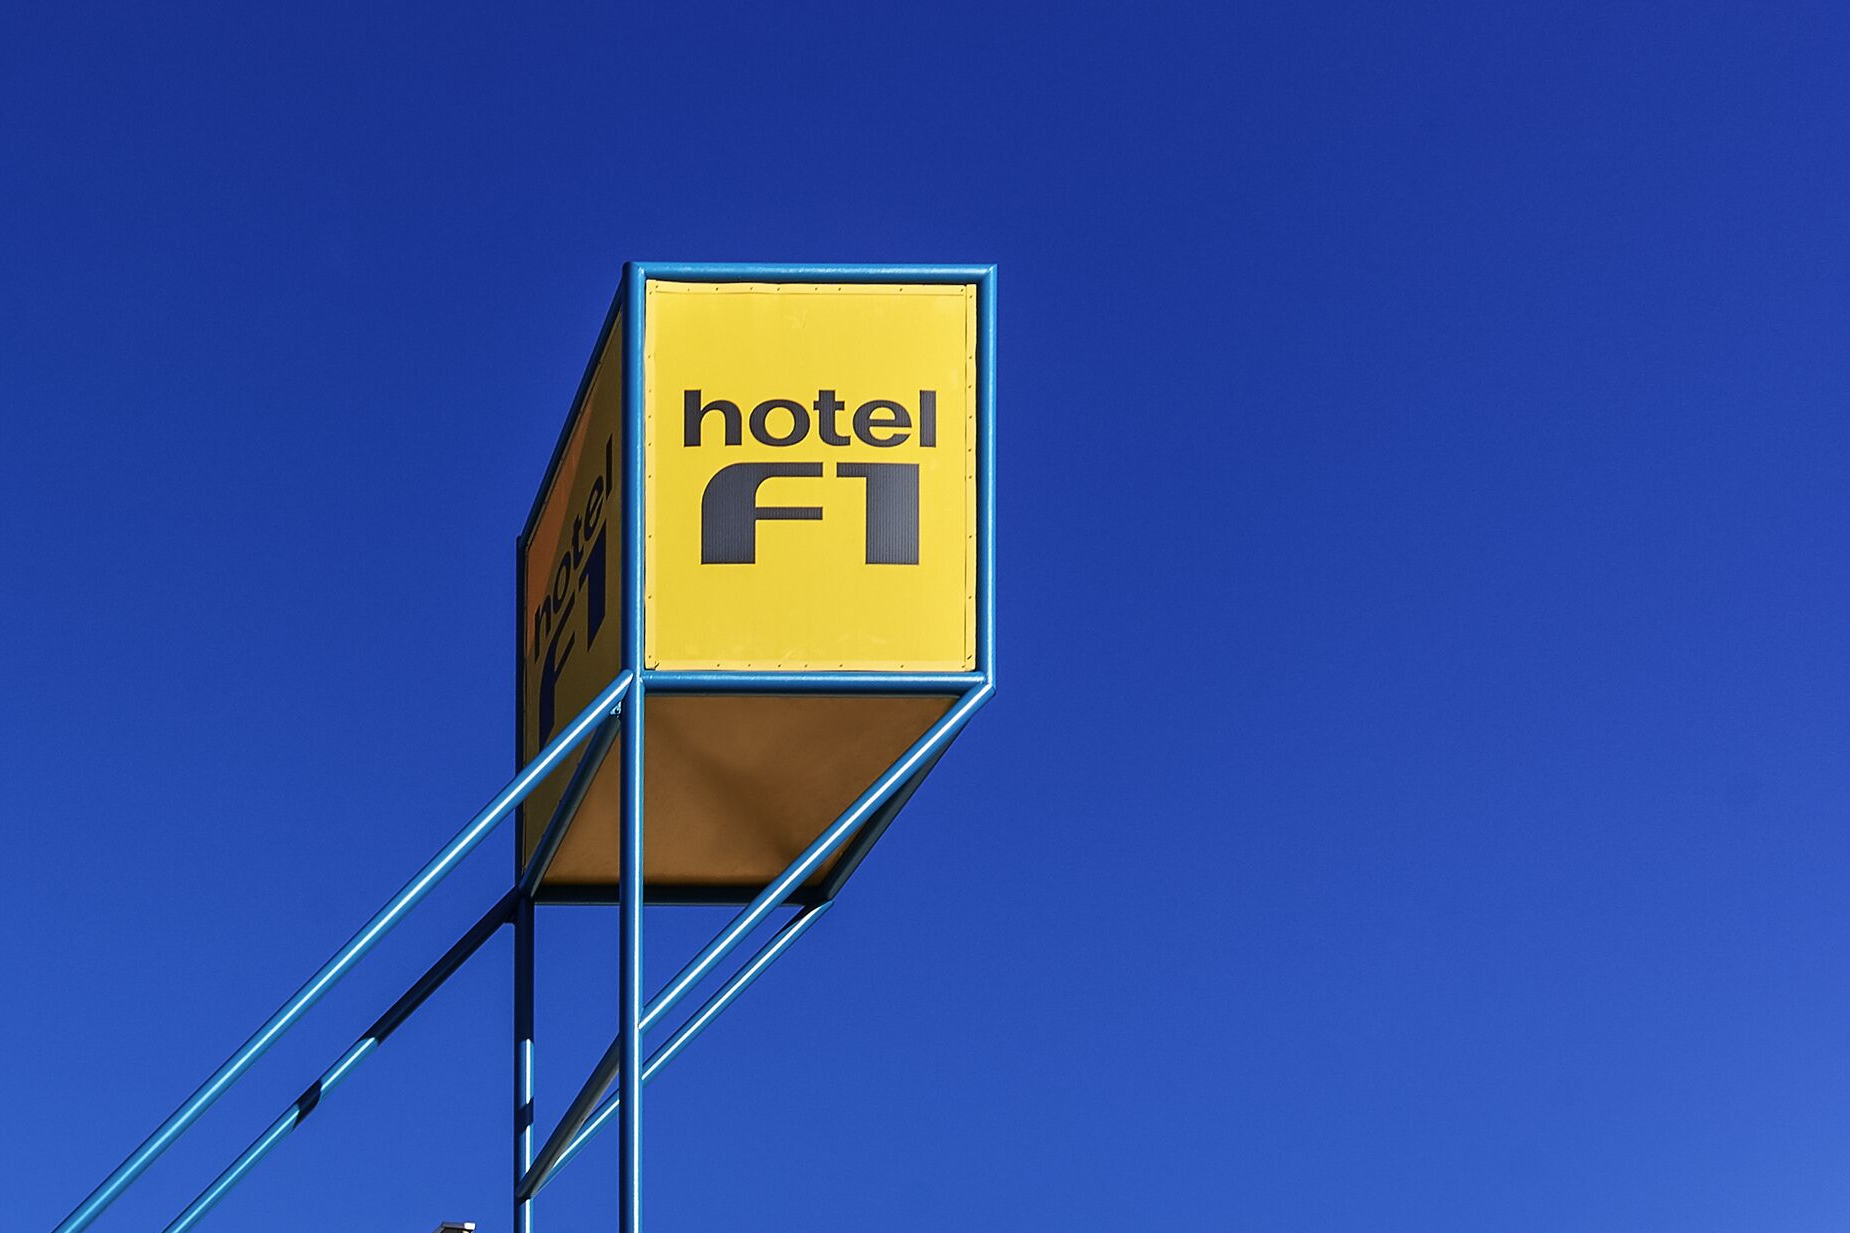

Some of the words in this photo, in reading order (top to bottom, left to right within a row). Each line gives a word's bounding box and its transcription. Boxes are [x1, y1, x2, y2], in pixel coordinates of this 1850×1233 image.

[683, 388, 937, 449] hotel
[534, 432, 613, 664] hotel
[700, 461, 920, 565] F1
